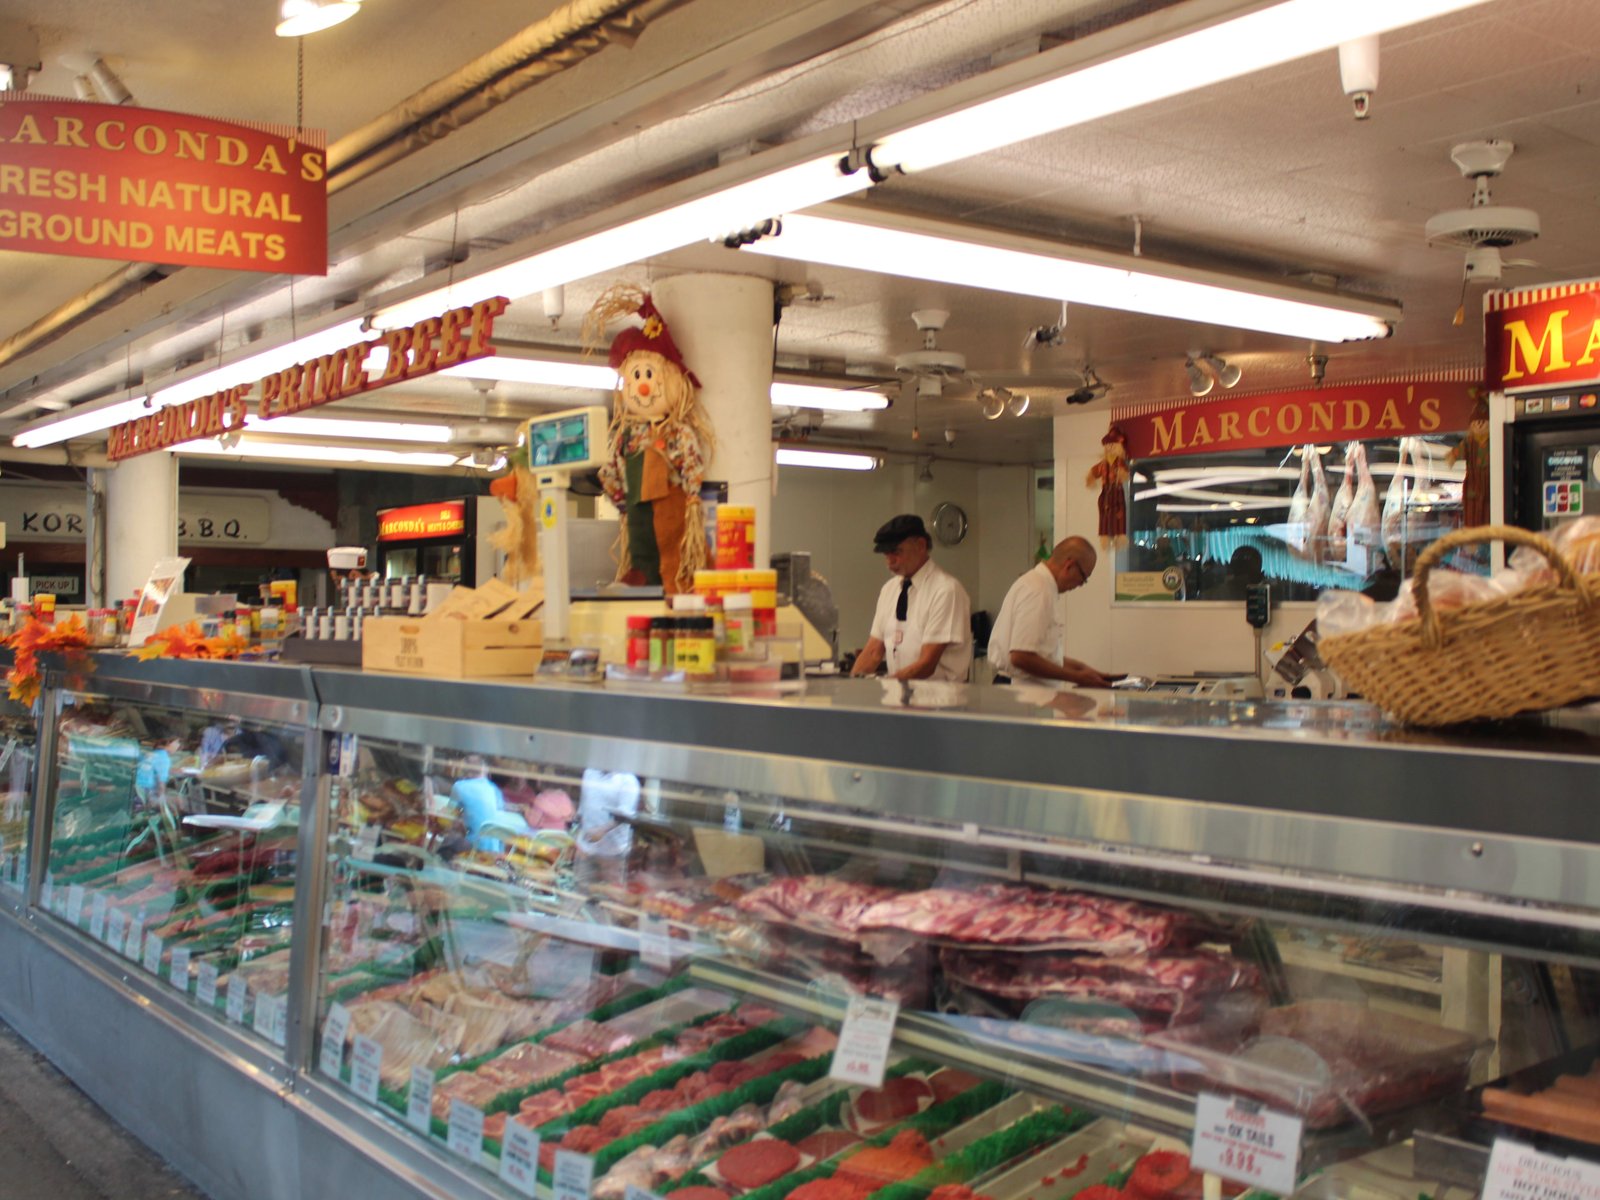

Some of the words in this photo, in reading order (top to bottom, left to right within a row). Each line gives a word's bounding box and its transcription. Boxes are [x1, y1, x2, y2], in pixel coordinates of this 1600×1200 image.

[0, 114, 323, 182] ARCONDA'S
[0, 165, 106, 203] RESH
[120, 177, 302, 222] NATURAL
[0, 209, 154, 248] GROUND
[165, 225, 286, 261] MEATS
[107, 384, 252, 461] MARCONDA'S
[258, 340, 376, 420] PRIME
[384, 296, 508, 380] BEEF
[1150, 386, 1441, 455] MARCONDA'S
[23, 512, 83, 533] KOR
[36, 581, 54, 589] PICK
[57, 581, 69, 589] UP
[1246, 1129, 1274, 1148] TAILS
[1519, 1156, 1582, 1181] DELICIOUS
